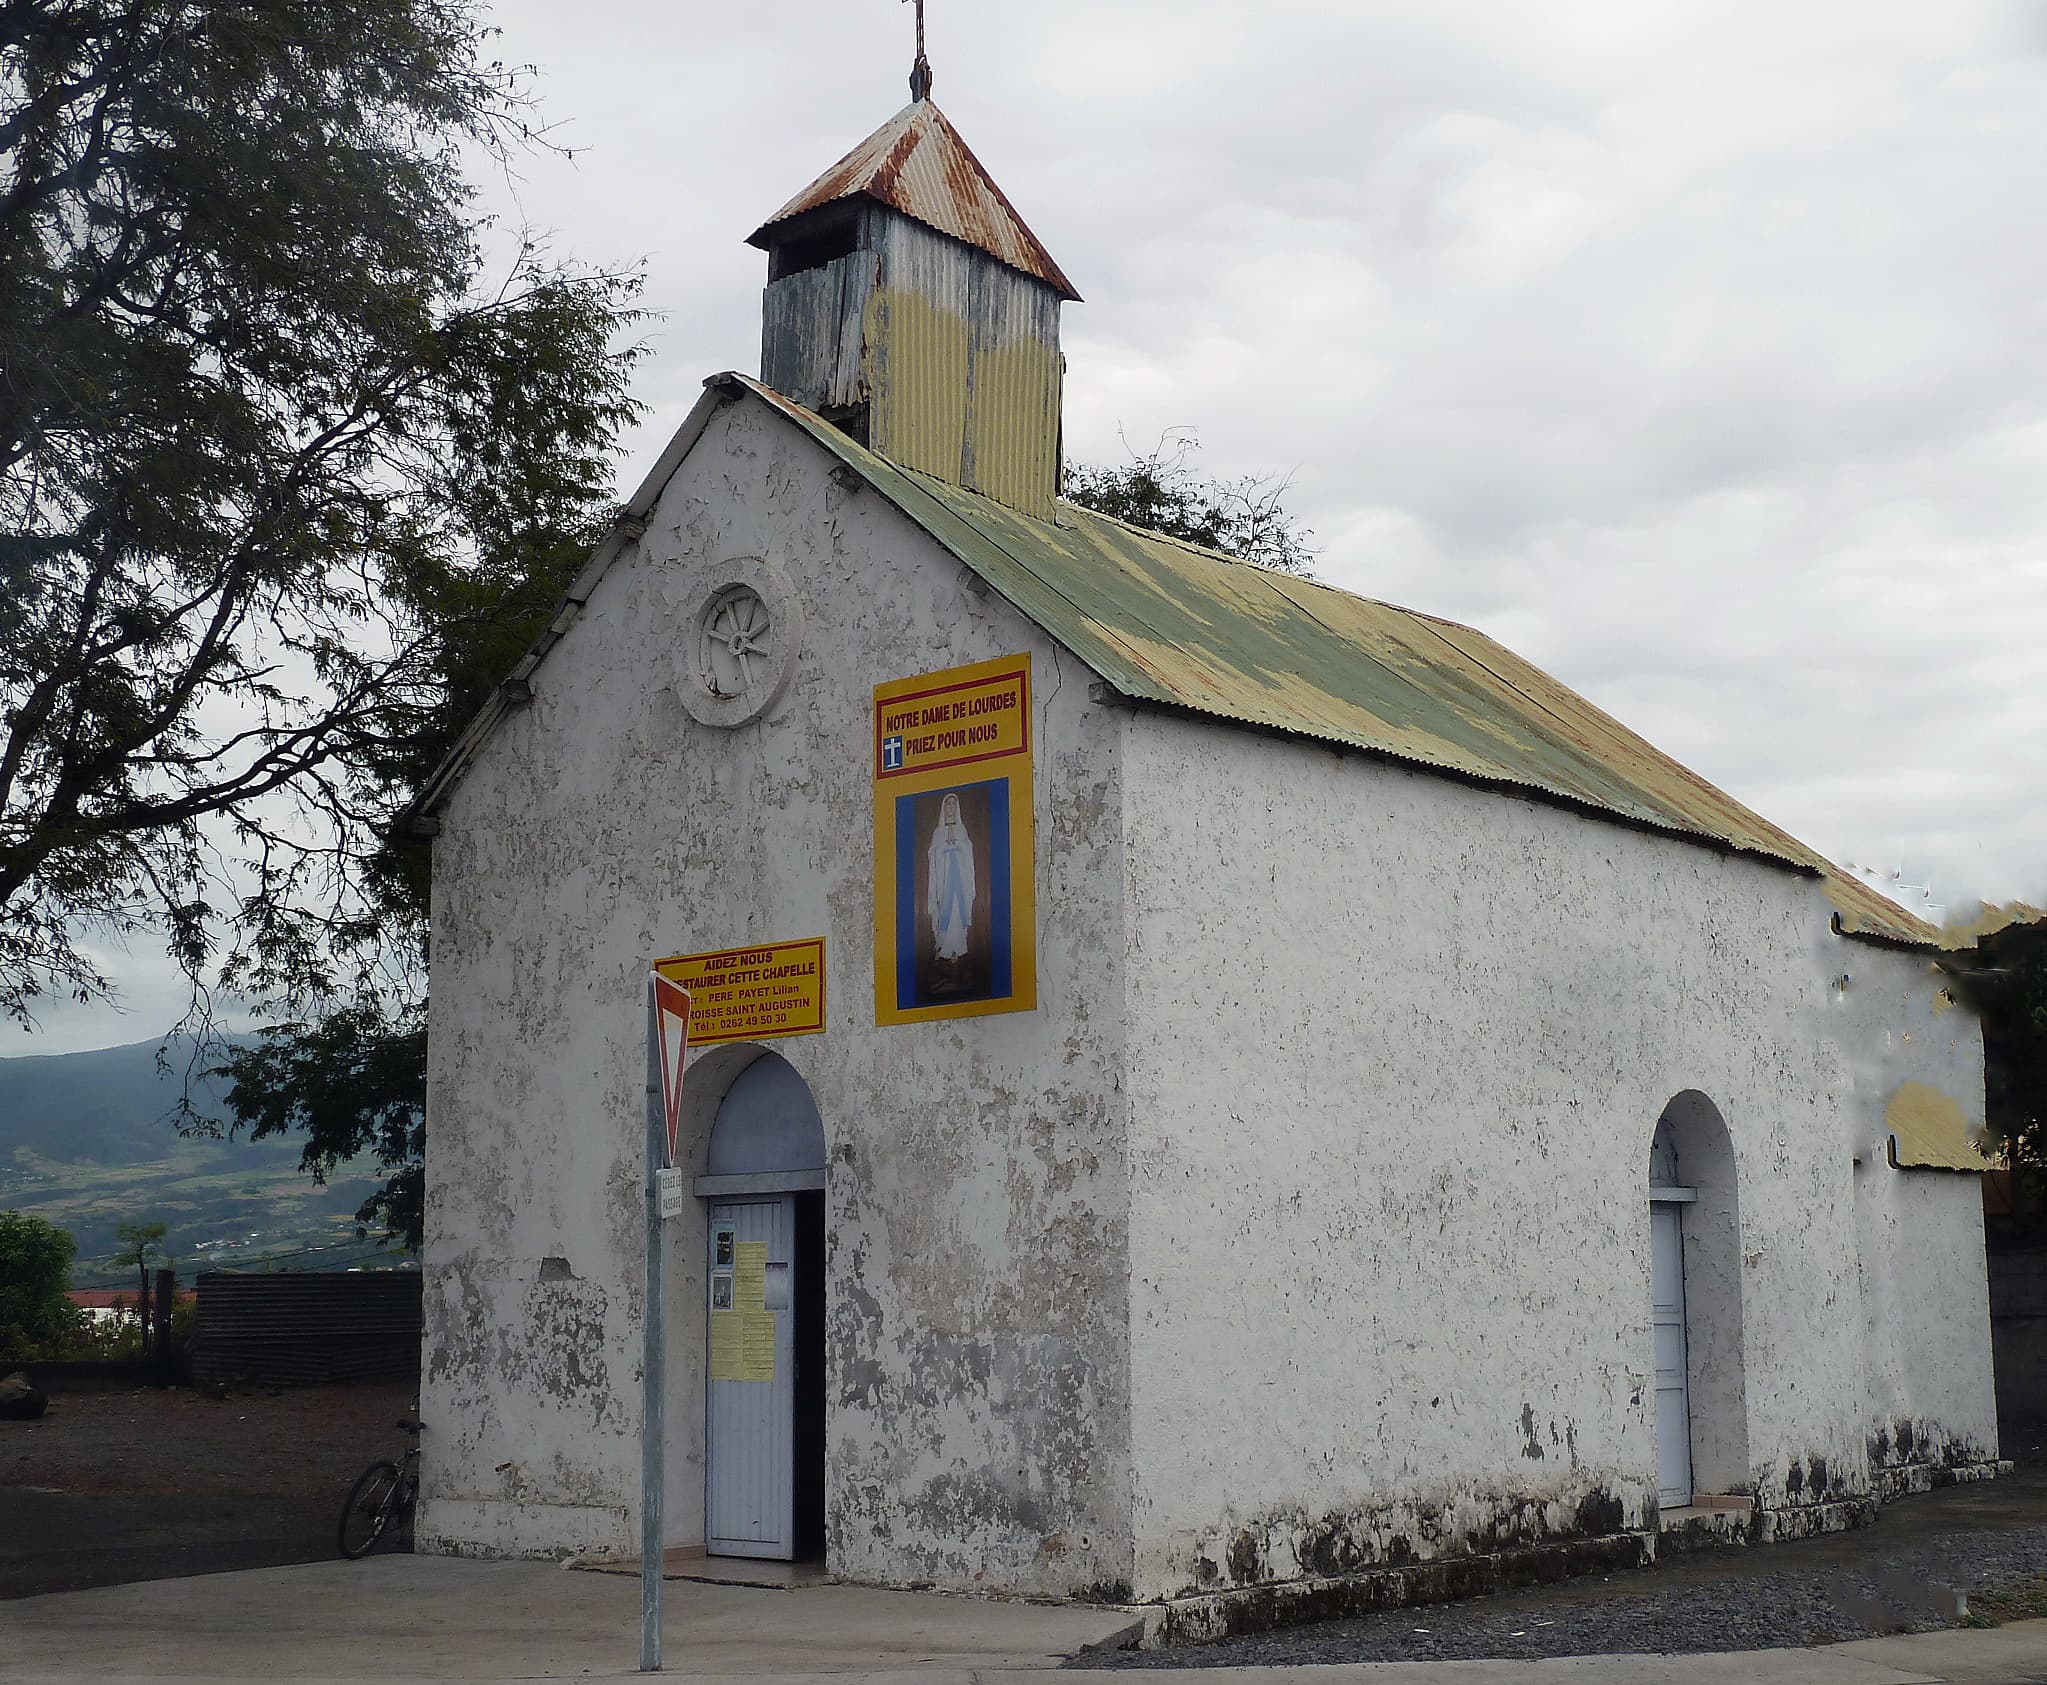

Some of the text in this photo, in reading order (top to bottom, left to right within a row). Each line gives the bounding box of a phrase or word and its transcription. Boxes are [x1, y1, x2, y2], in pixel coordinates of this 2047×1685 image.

[886, 691, 1017, 732] NOTRE DAME DE LOURDES
[906, 723, 998, 756] PRIEZ POUR NOUS
[704, 951, 773, 972] AIDEZ NOUS
[674, 962, 815, 990] ESTAURER CETTE CHAPELLE
[708, 991, 733, 1003] PERE
[738, 986, 770, 1000] PAYET
[772, 985, 799, 996] Lilian
[690, 998, 810, 1020] ROISSE SAINT AUGUSTIN
[720, 1018, 743, 1029] 0262
[746, 1016, 758, 1026] 49
[760, 1014, 773, 1025] 50
[775, 1013, 787, 1023] 30
